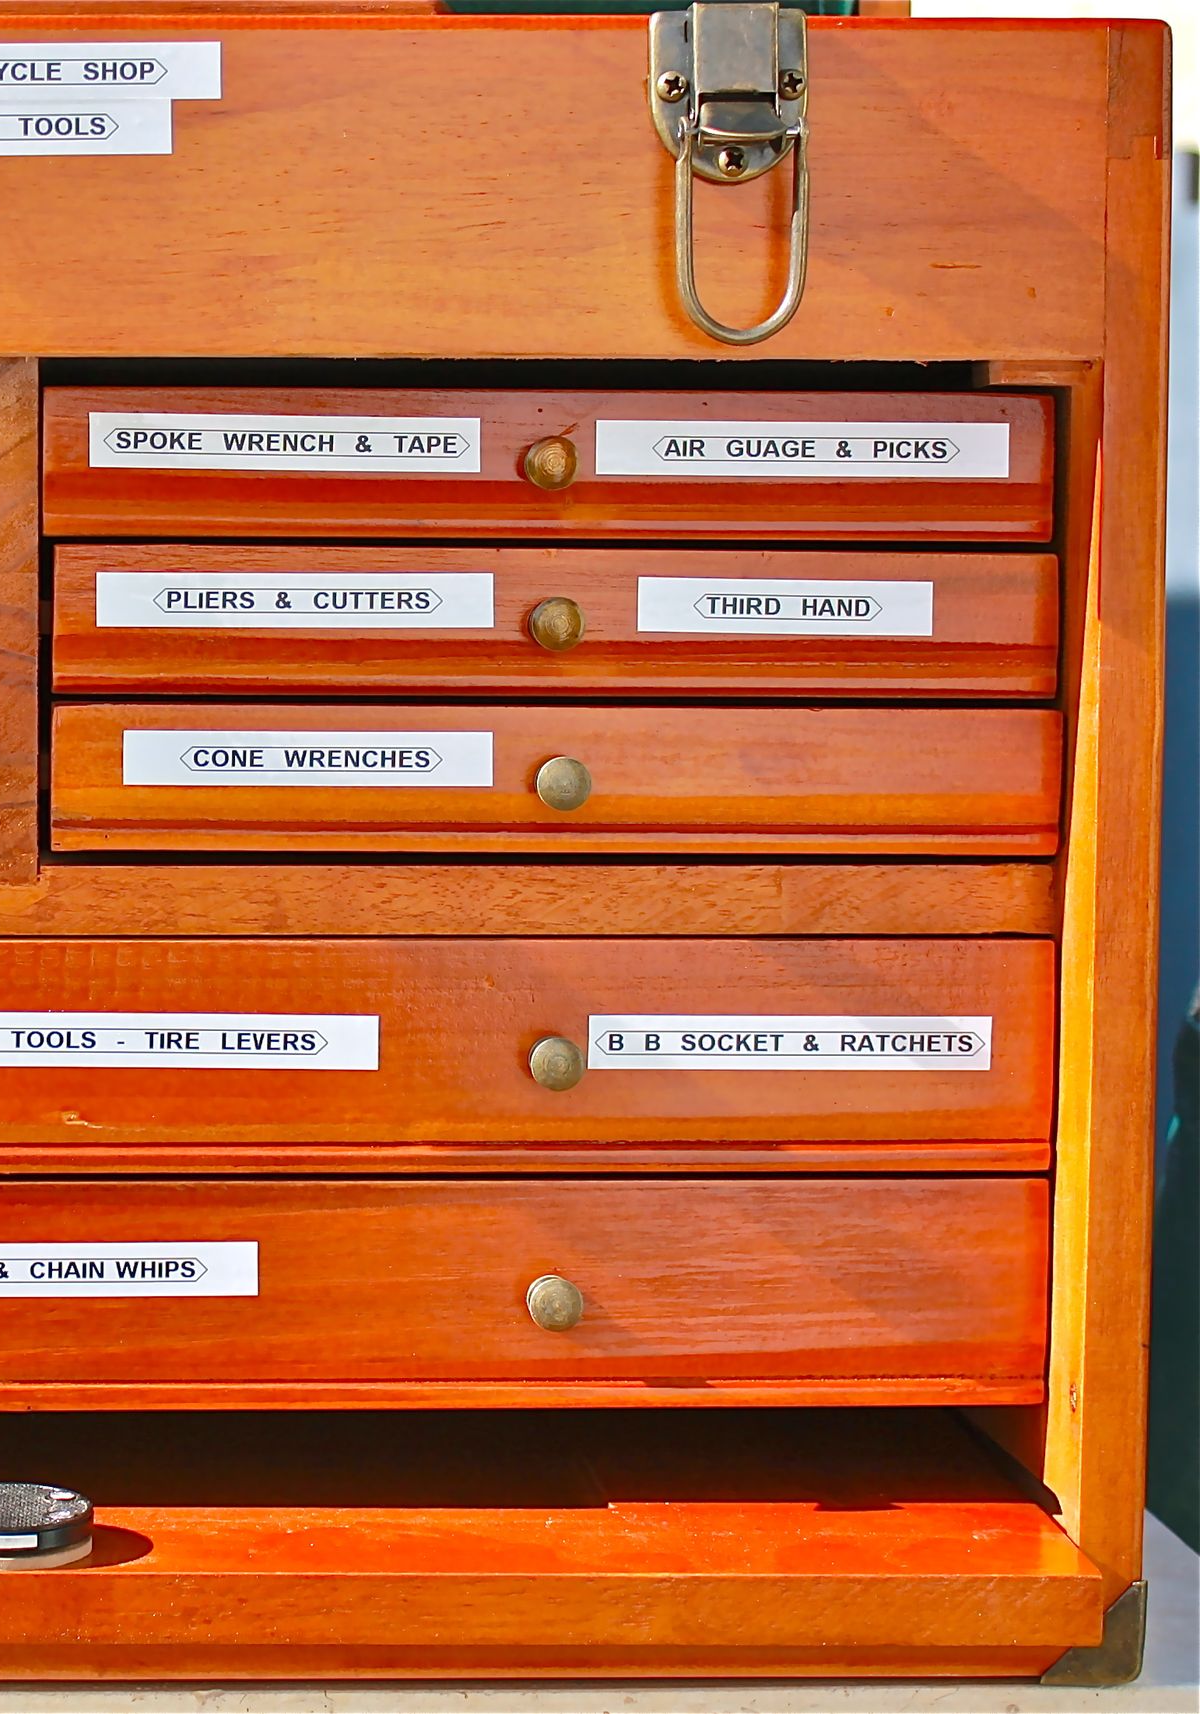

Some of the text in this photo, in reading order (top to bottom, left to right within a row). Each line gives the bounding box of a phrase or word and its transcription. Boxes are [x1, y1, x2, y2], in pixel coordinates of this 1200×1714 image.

[83, 61, 155, 81] SHOP
[18, 117, 106, 136] TOOLS
[116, 431, 457, 454] SPOKE WRENCH & TAPE
[664, 439, 947, 459] AIR GUAGE & PICKS
[167, 591, 430, 610] PLIERS & CUTTERS
[706, 596, 870, 617] THIRD HAND
[193, 749, 430, 768] CONE WRENCHES
[10, 1030, 97, 1049] TOOLS
[144, 1031, 200, 1050] TIRE
[221, 1032, 316, 1051] LEVERS
[608, 1033, 973, 1053] B B SOCKET & RATCHETS
[29, 1261, 104, 1279] CHAIN
[115, 1260, 196, 1279] WHIPS
